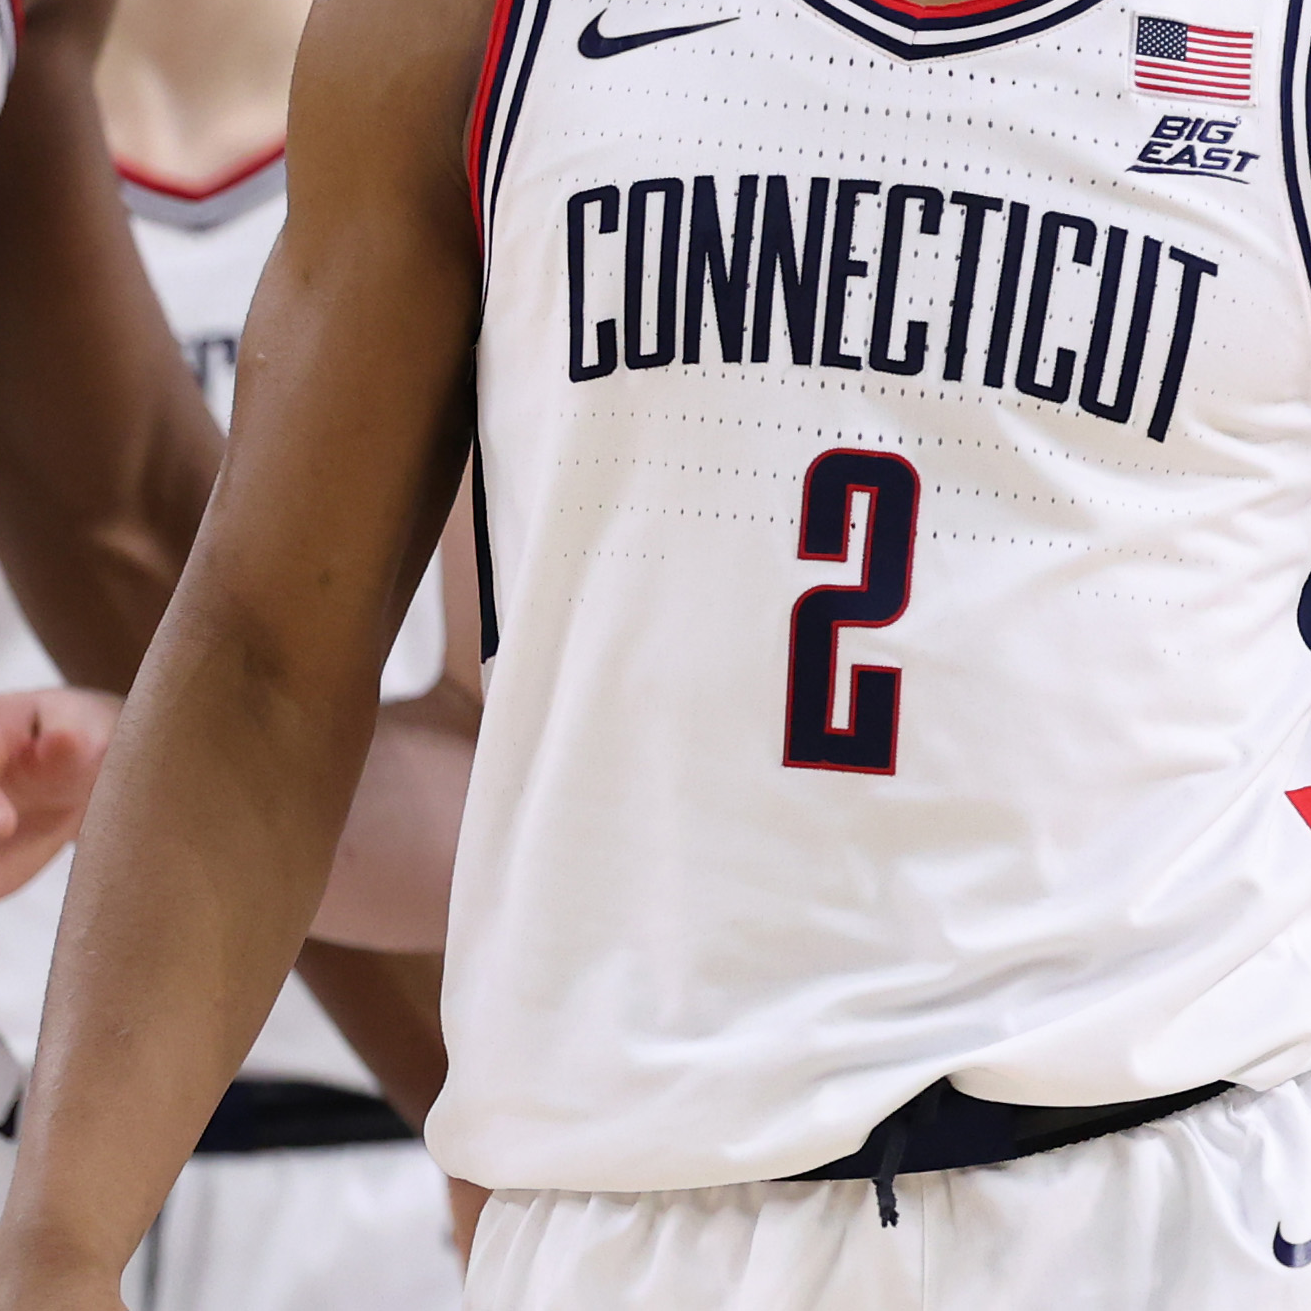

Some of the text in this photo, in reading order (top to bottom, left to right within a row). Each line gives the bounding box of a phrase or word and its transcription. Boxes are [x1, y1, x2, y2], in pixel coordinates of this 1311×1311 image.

[1137, 140, 1260, 172] EAST
[1150, 115, 1238, 144] BIG
[567, 174, 1218, 443] CONNECTICUT
[782, 447, 920, 776] 2
